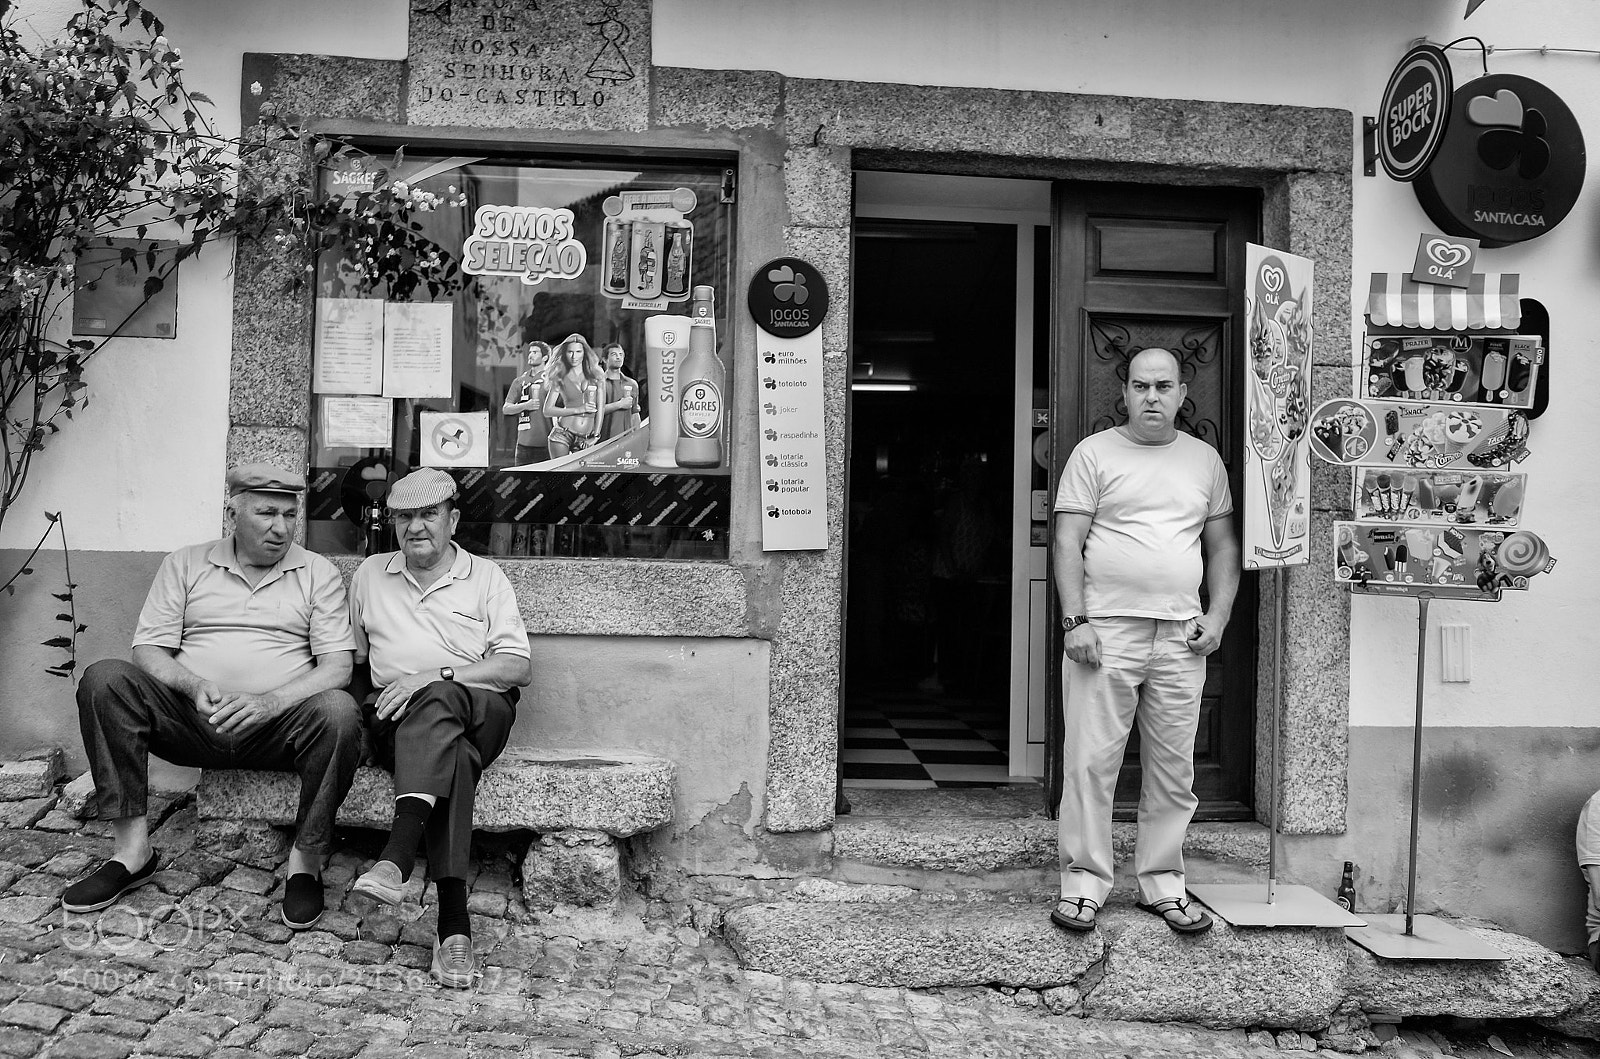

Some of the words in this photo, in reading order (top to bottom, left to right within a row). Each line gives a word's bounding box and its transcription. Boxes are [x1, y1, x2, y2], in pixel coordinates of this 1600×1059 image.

[482, 15, 516, 32] DE
[450, 39, 541, 58] NOSSA
[444, 63, 570, 84] SENHORA
[1389, 82, 1433, 128] SUPER
[1392, 103, 1432, 147] BOCK
[1474, 210, 1546, 227] SANTACASA
[480, 211, 568, 241] SOMOS
[468, 238, 581, 279] SELEÇÃO
[1428, 263, 1454, 280] OLÁ
[1265, 293, 1279, 306] OLÁ
[770, 309, 810, 324] JOGOS
[1405, 340, 1430, 348] PRAZER
[1454, 336, 1469, 349] M
[778, 357, 808, 365] milhões
[660, 350, 677, 403] SAGRES
[778, 380, 807, 388] totoloto
[683, 400, 717, 412] SAGRES
[780, 406, 798, 414] joker
[780, 431, 819, 440] raspadinha
[617, 457, 640, 466] SAGRES
[780, 460, 808, 468] clássica
[781, 485, 810, 493] popular
[781, 508, 812, 516] totobola
